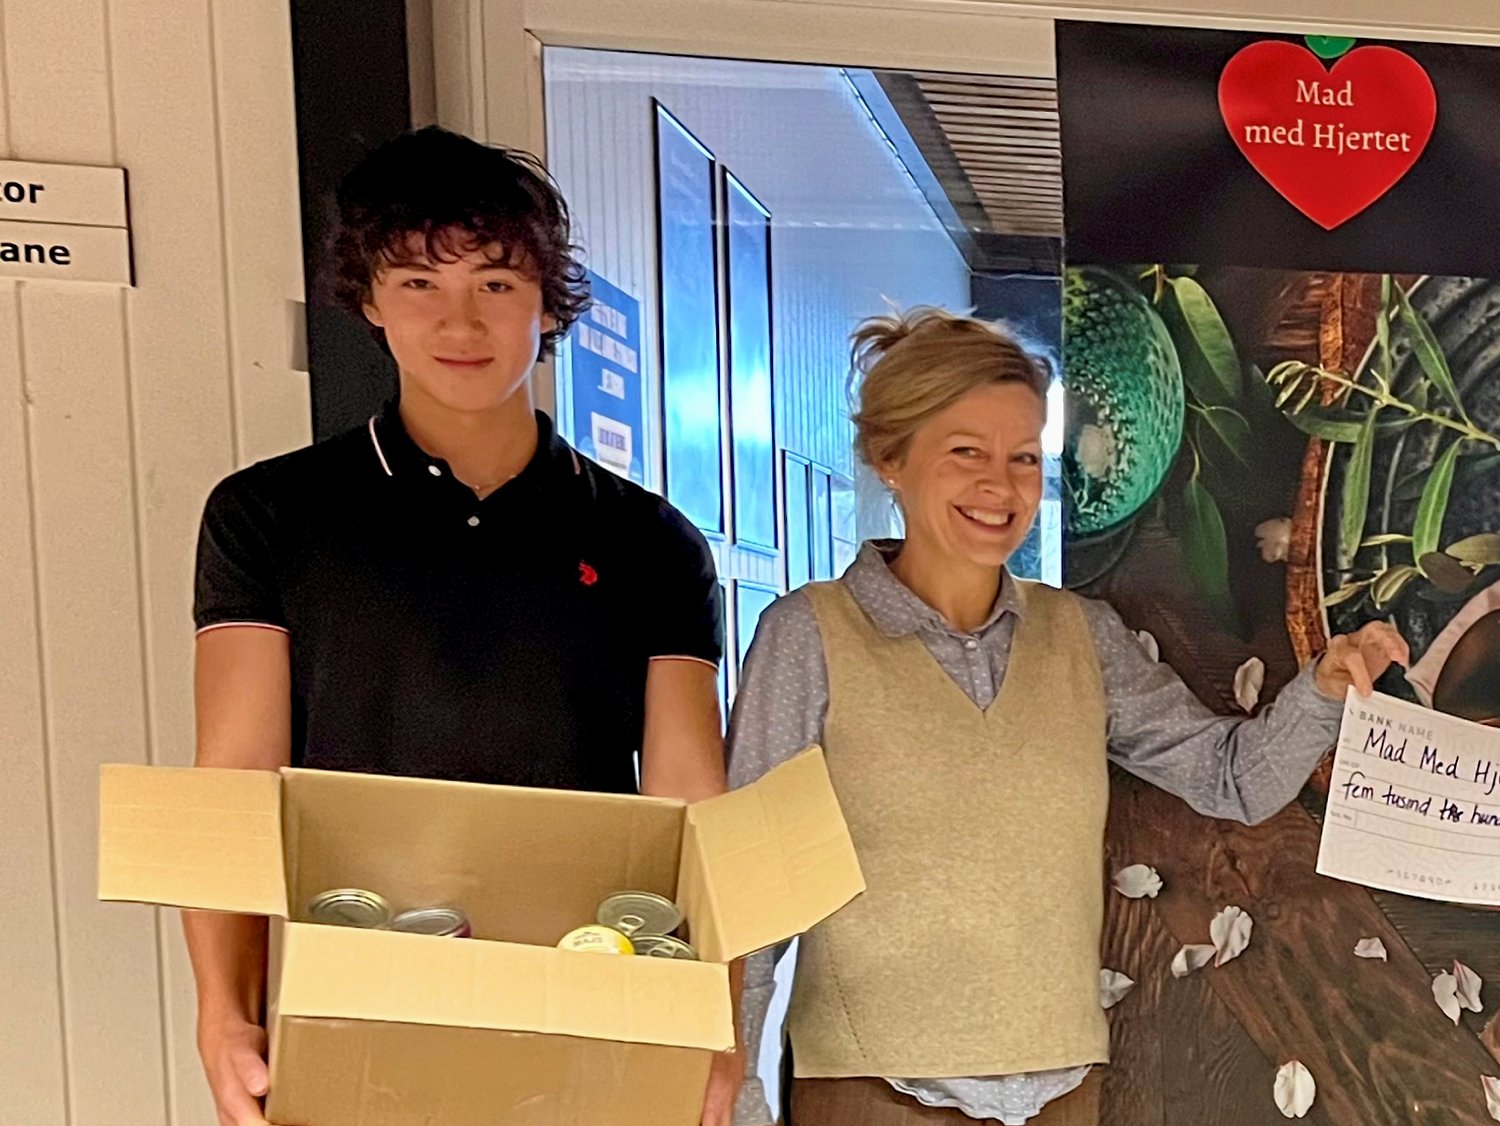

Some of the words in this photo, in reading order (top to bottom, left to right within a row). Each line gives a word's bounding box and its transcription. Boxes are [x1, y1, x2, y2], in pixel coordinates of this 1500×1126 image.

[1296, 79, 1353, 106] Mad
[1245, 119, 1304, 146] med
[1313, 123, 1411, 155] Hjertet
[0, 181, 45, 204] or
[0, 242, 71, 265] ane
[1359, 711, 1393, 728] BANK
[1400, 723, 1434, 742] NAME
[1363, 728, 1407, 764] Mad
[1420, 746, 1459, 779] Med
[1342, 771, 1374, 800] fem
